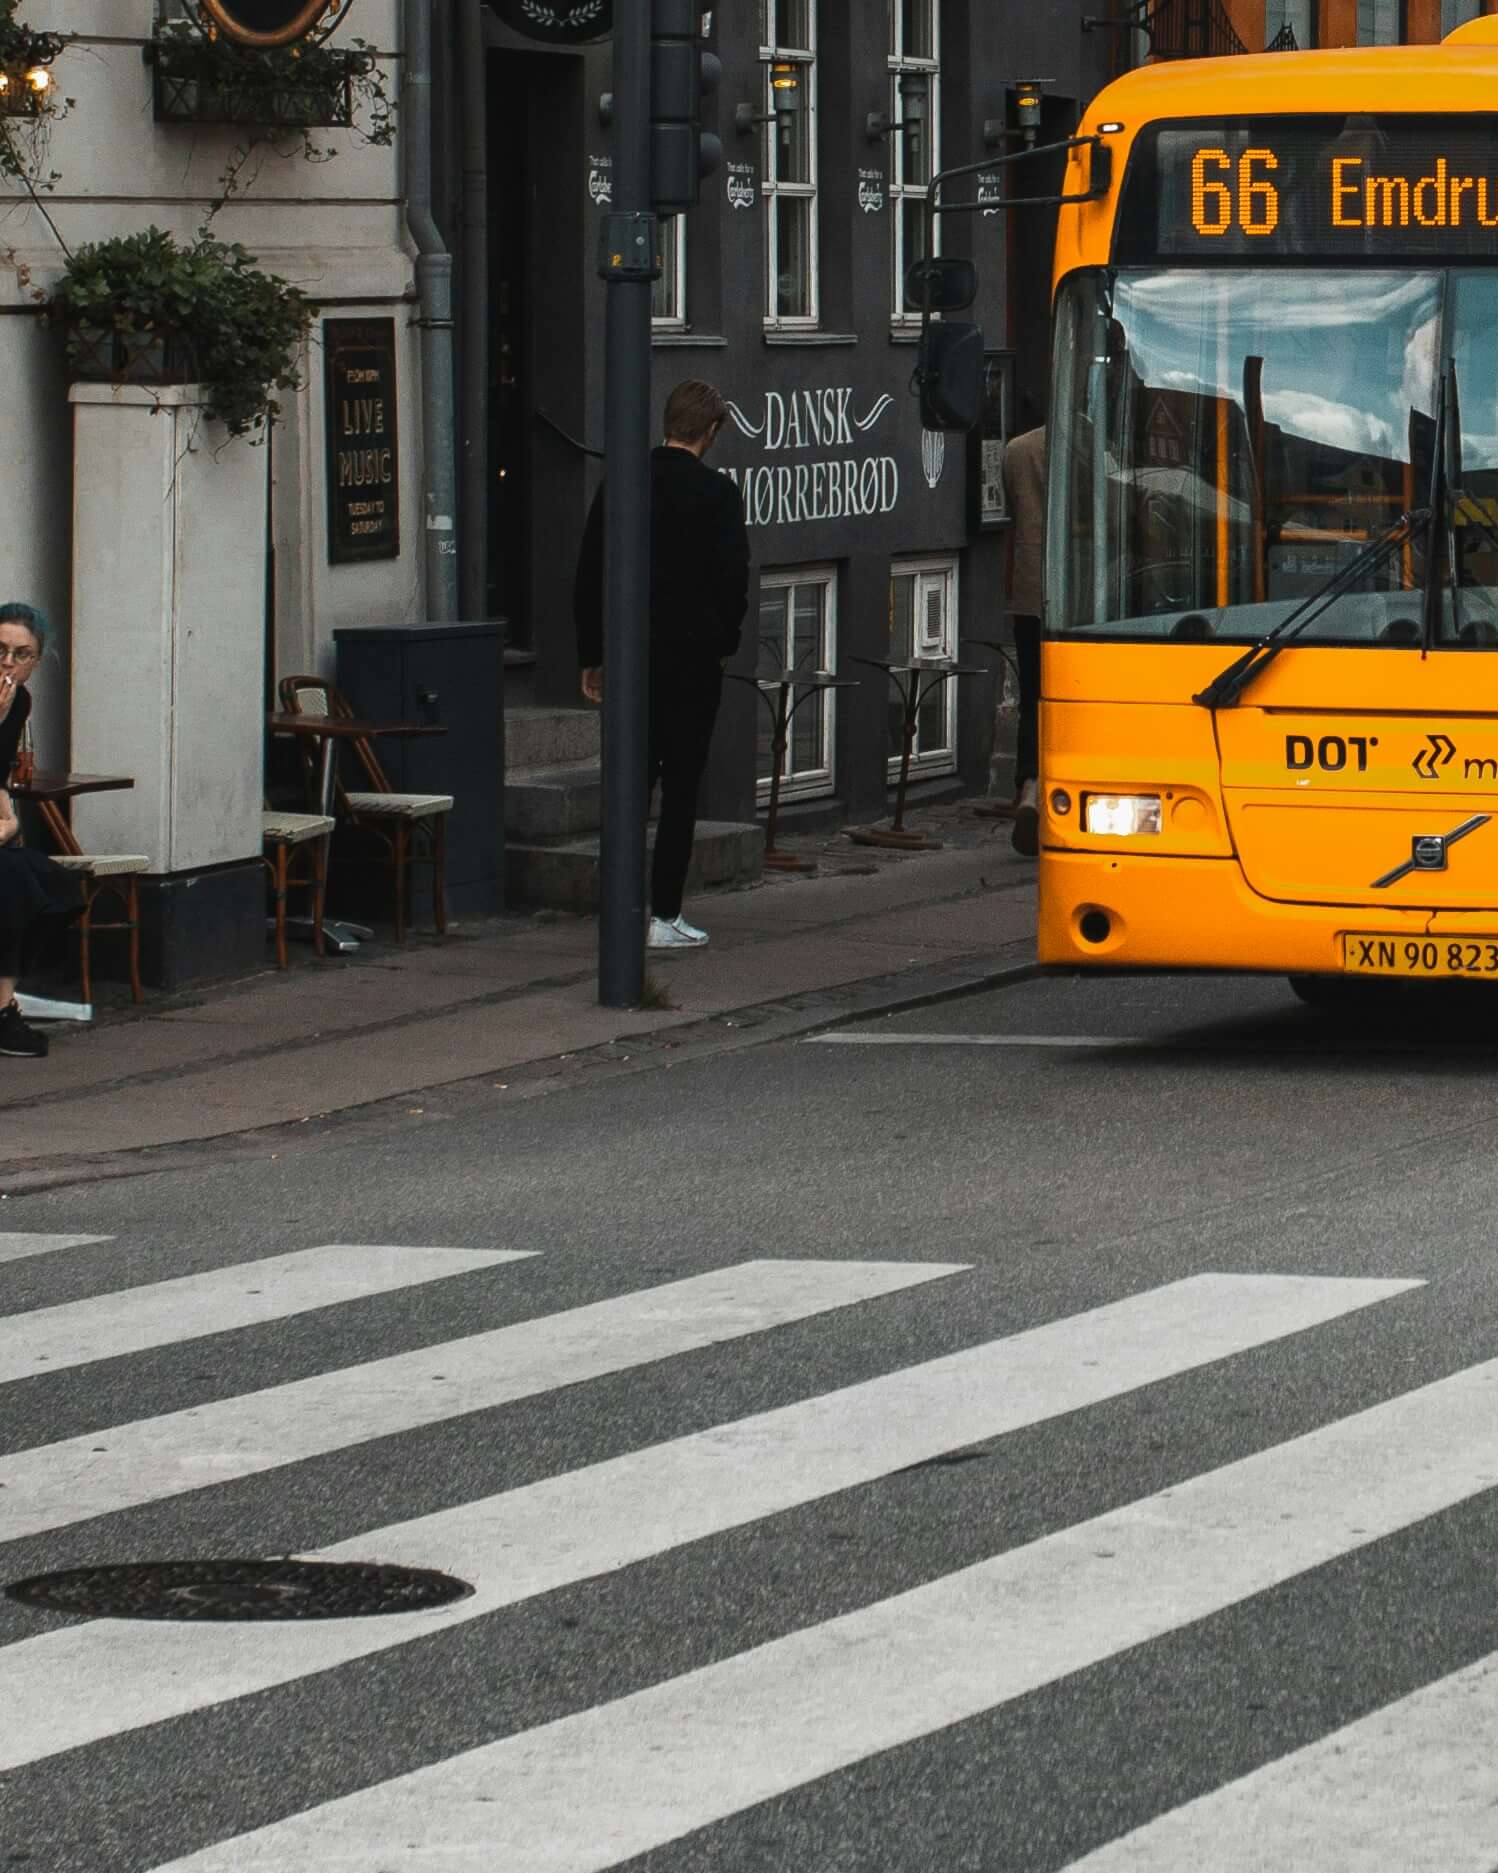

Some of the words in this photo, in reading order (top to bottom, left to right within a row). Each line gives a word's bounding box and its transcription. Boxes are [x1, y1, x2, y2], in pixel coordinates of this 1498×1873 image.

[727, 176, 755, 208] Carlsberg
[1192, 149, 1278, 235] 66
[343, 398, 385, 435] LIVE
[764, 388, 854, 450] DANSK
[338, 448, 392, 488] MUSIC
[717, 456, 898, 526] MØRREBRØD
[1286, 734, 1377, 772] DOT
[1358, 940, 1395, 968] XN
[1404, 942, 1438, 970] 90
